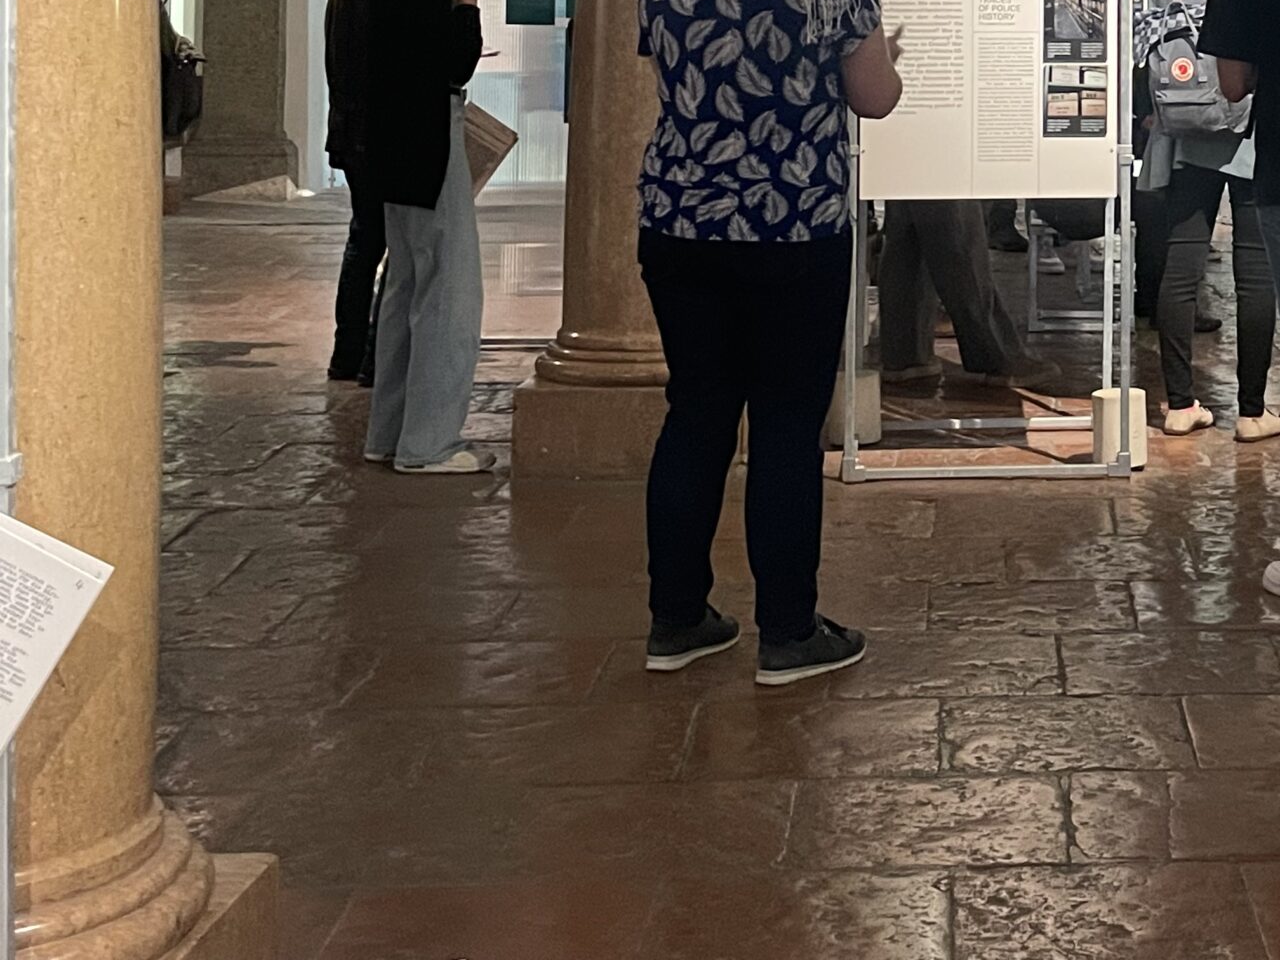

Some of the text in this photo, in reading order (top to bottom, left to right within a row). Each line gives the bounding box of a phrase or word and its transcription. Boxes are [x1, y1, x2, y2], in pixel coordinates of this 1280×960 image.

[979, 4, 1021, 12] OF POLICE
[979, 12, 1015, 21] HISTORY
